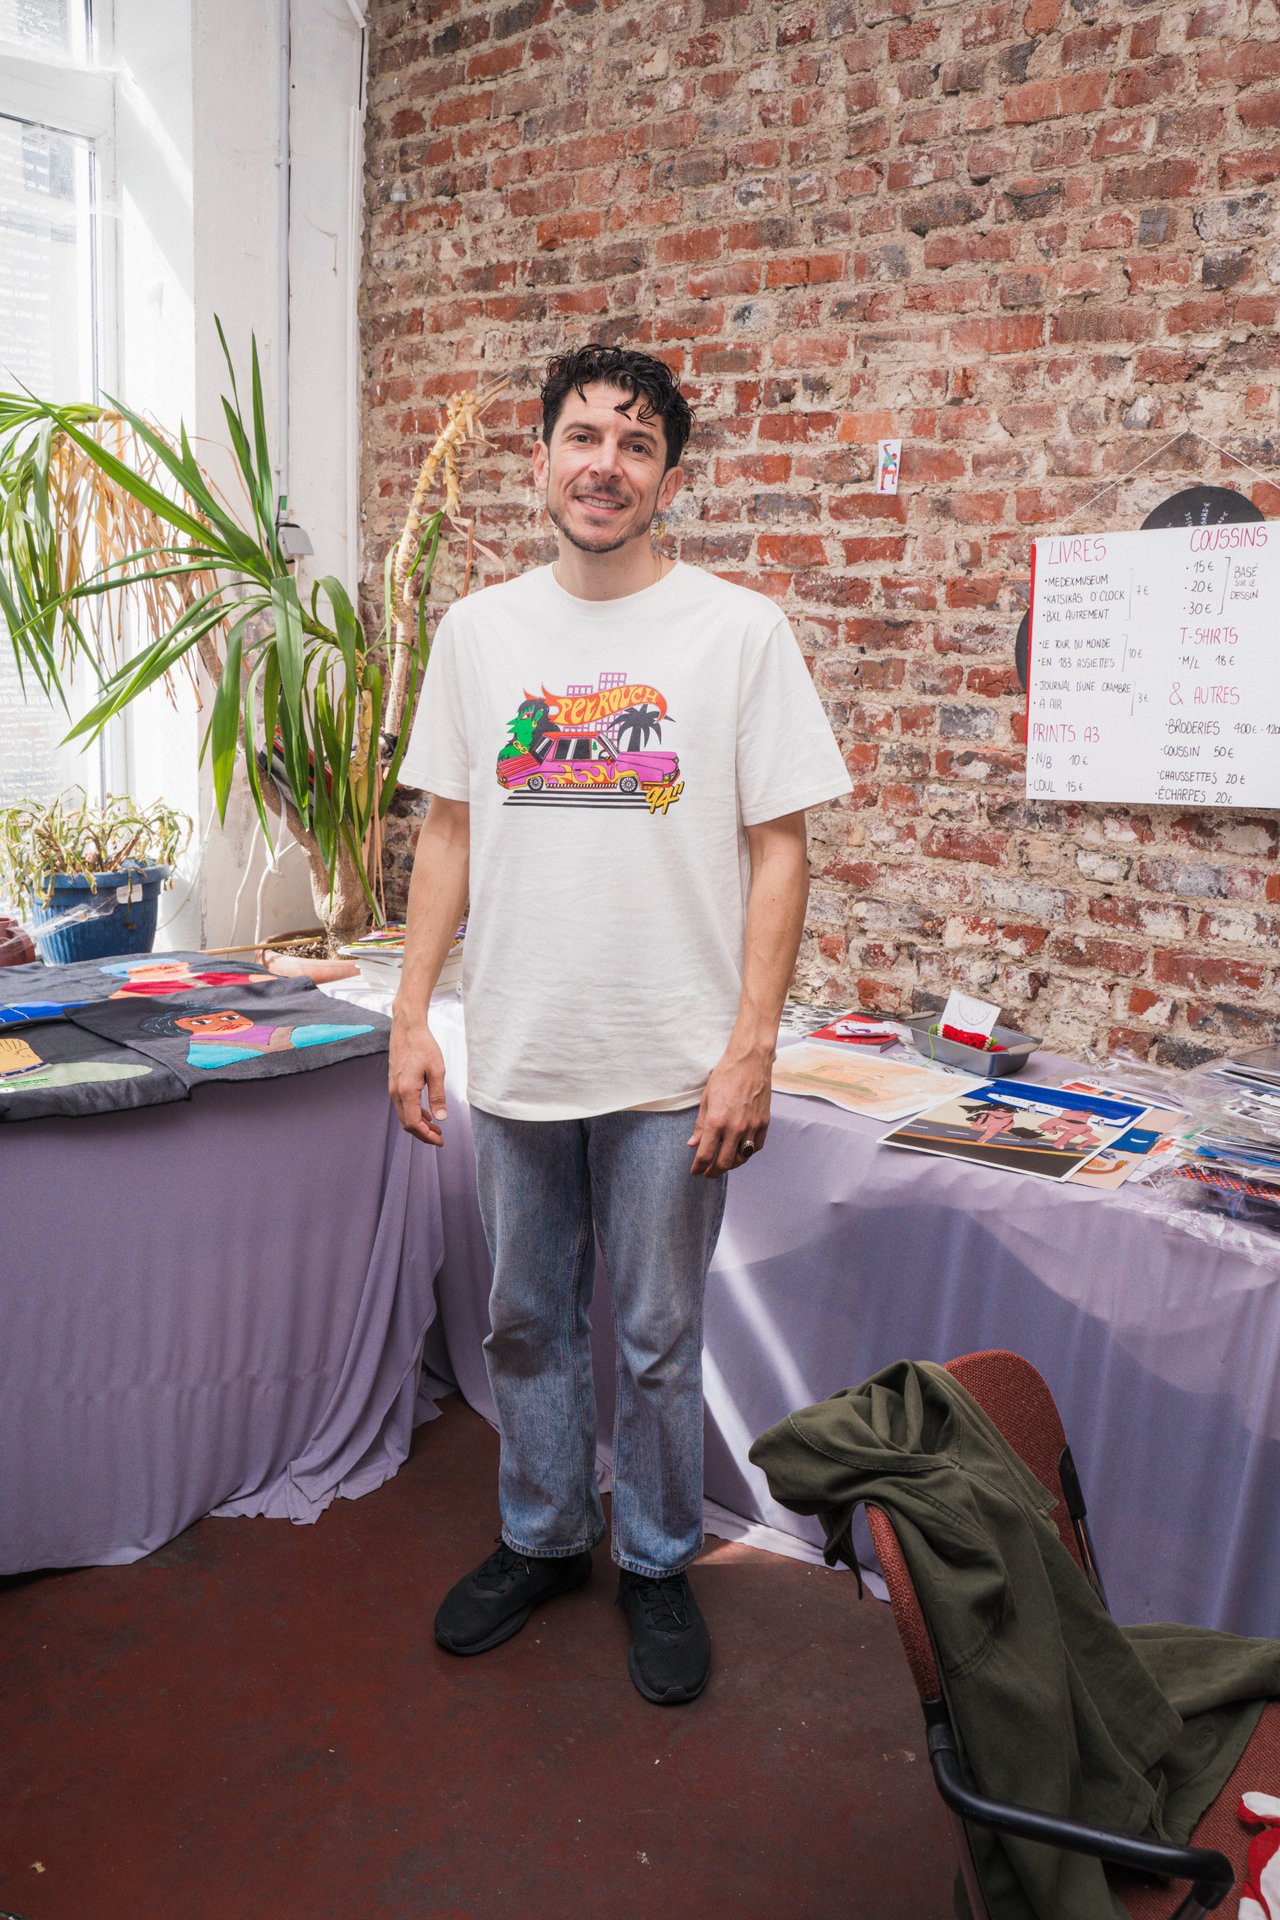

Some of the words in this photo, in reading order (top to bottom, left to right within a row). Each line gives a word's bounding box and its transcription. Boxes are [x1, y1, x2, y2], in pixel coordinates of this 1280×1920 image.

[1190, 526, 1268, 553] COUSSINS
[1048, 538, 1107, 565] LIVRES
[1048, 574, 1109, 587] MEDEXMUSEUM
[1046, 593, 1083, 604] KATSIKAS
[1090, 590, 1125, 602] O'CLOCK
[1230, 589, 1259, 600] DESSIN
[1046, 611, 1061, 623] BXL
[1065, 609, 1110, 621] AUTREMENT
[1180, 626, 1239, 645] T-SHIRTS
[1042, 639, 1050, 649] LE
[1055, 639, 1070, 649] TOUR
[1074, 639, 1084, 649] DU
[1086, 638, 1111, 648] MONDE
[1041, 657, 1052, 667] EN
[1076, 658, 1115, 668] ASSIETTES
[1181, 655, 1200, 670] M/L
[1039, 680, 1071, 692] JOURNAL
[1169, 682, 1184, 705] &
[1194, 685, 1240, 705] AUTRES
[1049, 698, 1063, 709] AIR
[1032, 722, 1076, 743] PRINTS
[1083, 726, 1100, 743] A3
[1168, 718, 1220, 736] BRODERIES
[1163, 745, 1200, 758] COUSSIN
[1036, 752, 1052, 769] N/B
[1159, 770, 1217, 785] CHAUSSETTES
[1033, 779, 1056, 793] COUL
[1157, 785, 1206, 803] ÉCHARPES
